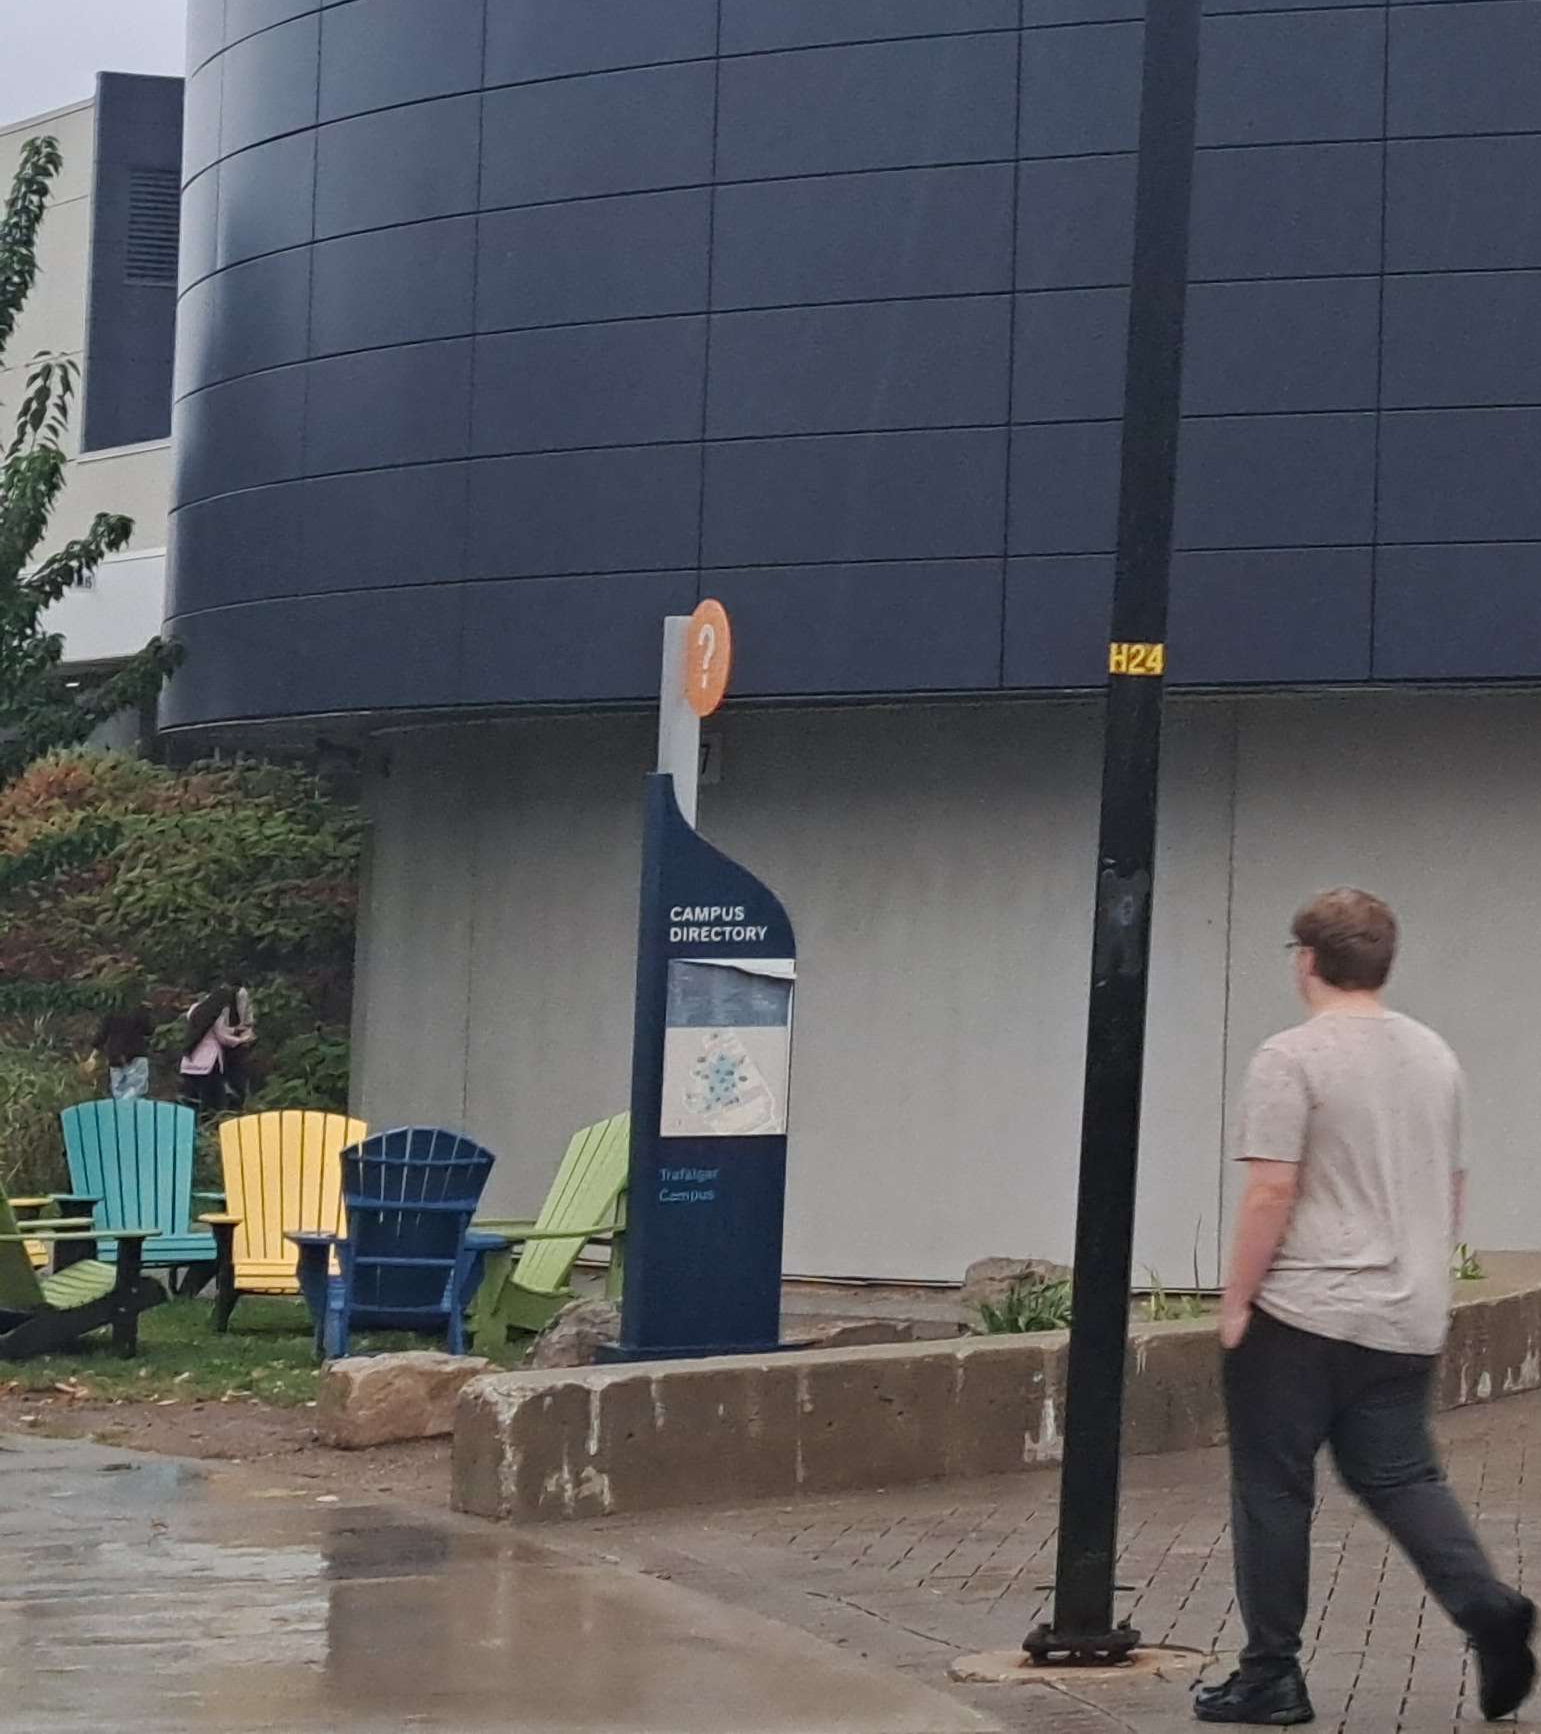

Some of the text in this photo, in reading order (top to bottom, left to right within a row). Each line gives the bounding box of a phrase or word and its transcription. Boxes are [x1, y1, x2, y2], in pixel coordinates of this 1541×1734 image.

[1109, 642, 1164, 675] H24
[670, 906, 745, 922] CAMPUS
[670, 926, 768, 942] DIRECTORY
[659, 1168, 719, 1183] Trafalgar
[659, 1188, 716, 1203] Campus
